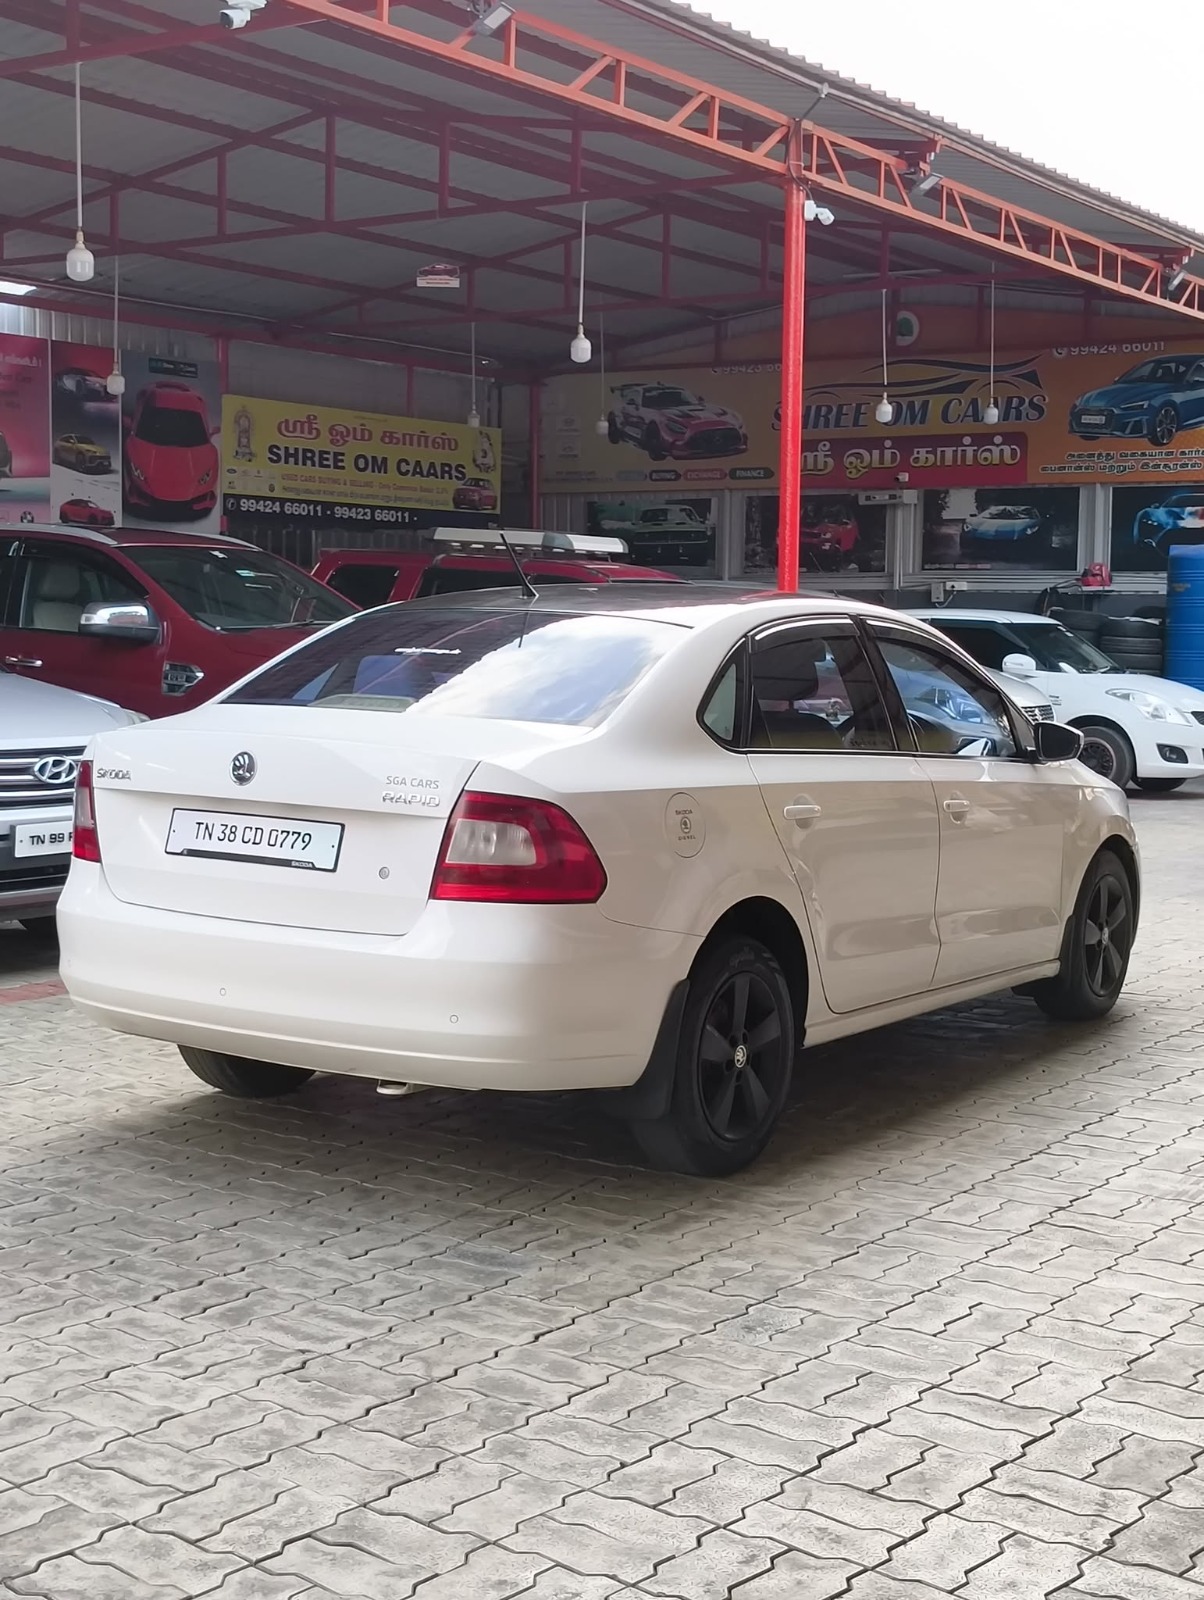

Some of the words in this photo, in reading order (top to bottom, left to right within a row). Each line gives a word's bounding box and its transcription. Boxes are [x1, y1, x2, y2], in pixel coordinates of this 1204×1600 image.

[380, 430, 459, 451] கார்ஸ்
[267, 444, 346, 471] SHREE
[354, 453, 388, 475] OM
[396, 458, 467, 482] CAARS
[843, 439, 901, 479] ஓம்
[909, 435, 1021, 467] கார்ஸ்
[240, 498, 281, 513] 99424
[284, 502, 322, 517] 66011
[334, 506, 371, 520] 99423
[374, 509, 409, 523] 66011
[386, 775, 407, 786] SGA
[410, 777, 440, 789] CARS
[382, 790, 441, 807] RAPID
[29, 834, 46, 846] TN
[49, 832, 65, 844] 99
[195, 822, 215, 840] TN
[217, 823, 238, 843] 38
[241, 826, 264, 846] CD
[267, 829, 312, 851] 0779
